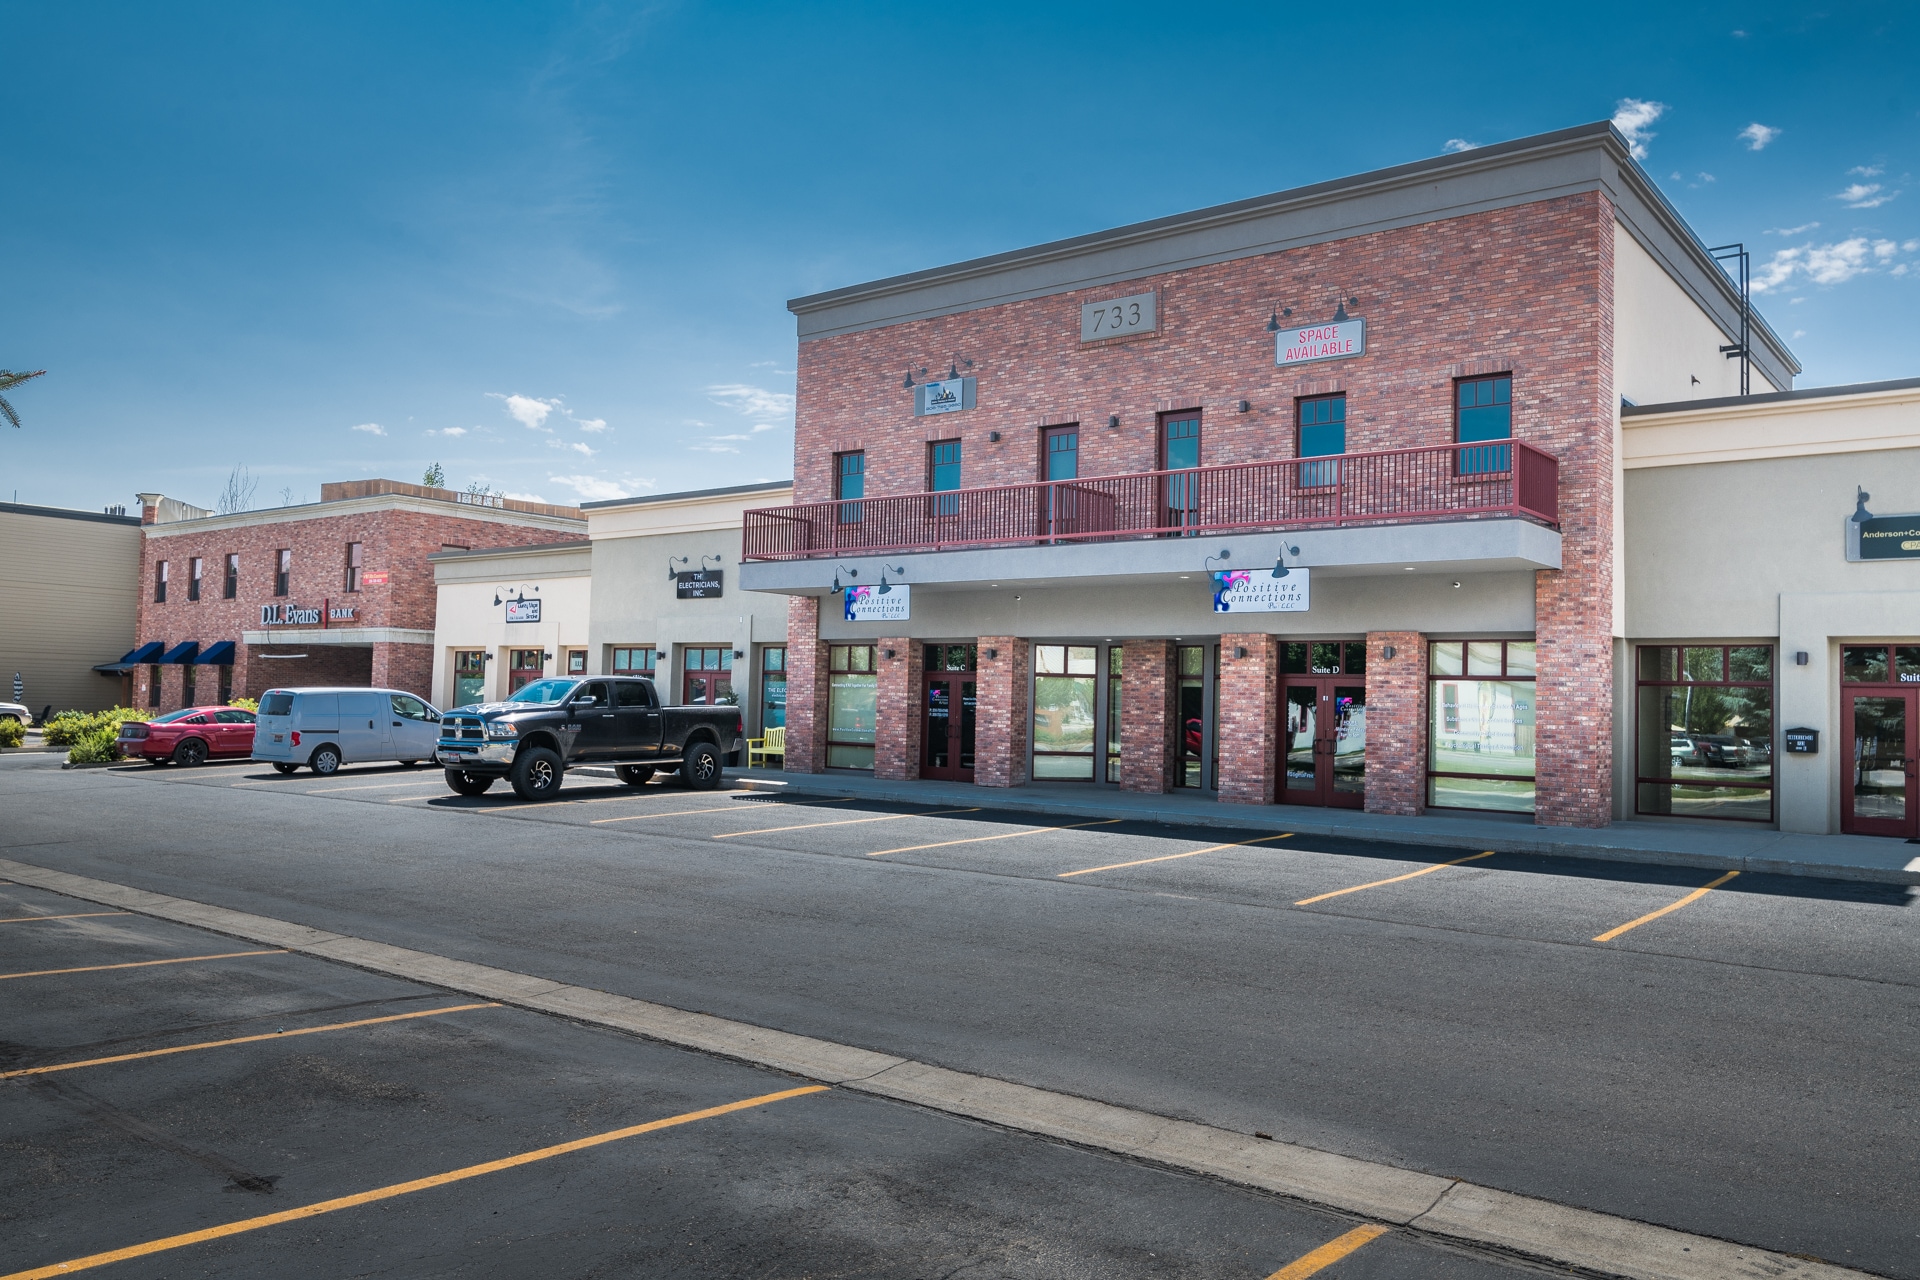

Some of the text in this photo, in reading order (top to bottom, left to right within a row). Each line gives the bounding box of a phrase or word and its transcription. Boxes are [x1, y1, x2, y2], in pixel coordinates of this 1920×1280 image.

[1093, 302, 1141, 333] 733
[1299, 325, 1339, 343] SPACE
[1285, 339, 1353, 361] AVAILABLE
[678, 581, 720, 589] ELECTRICIANS,
[1233, 580, 1297, 593] Positive
[692, 589, 705, 597] INC.
[859, 594, 902, 605] Positive
[1222, 588, 1302, 603] Connections
[850, 601, 905, 613] Connections
[260, 604, 354, 625] D.L. Evans BANK
[1311, 665, 1340, 674] Suite D
